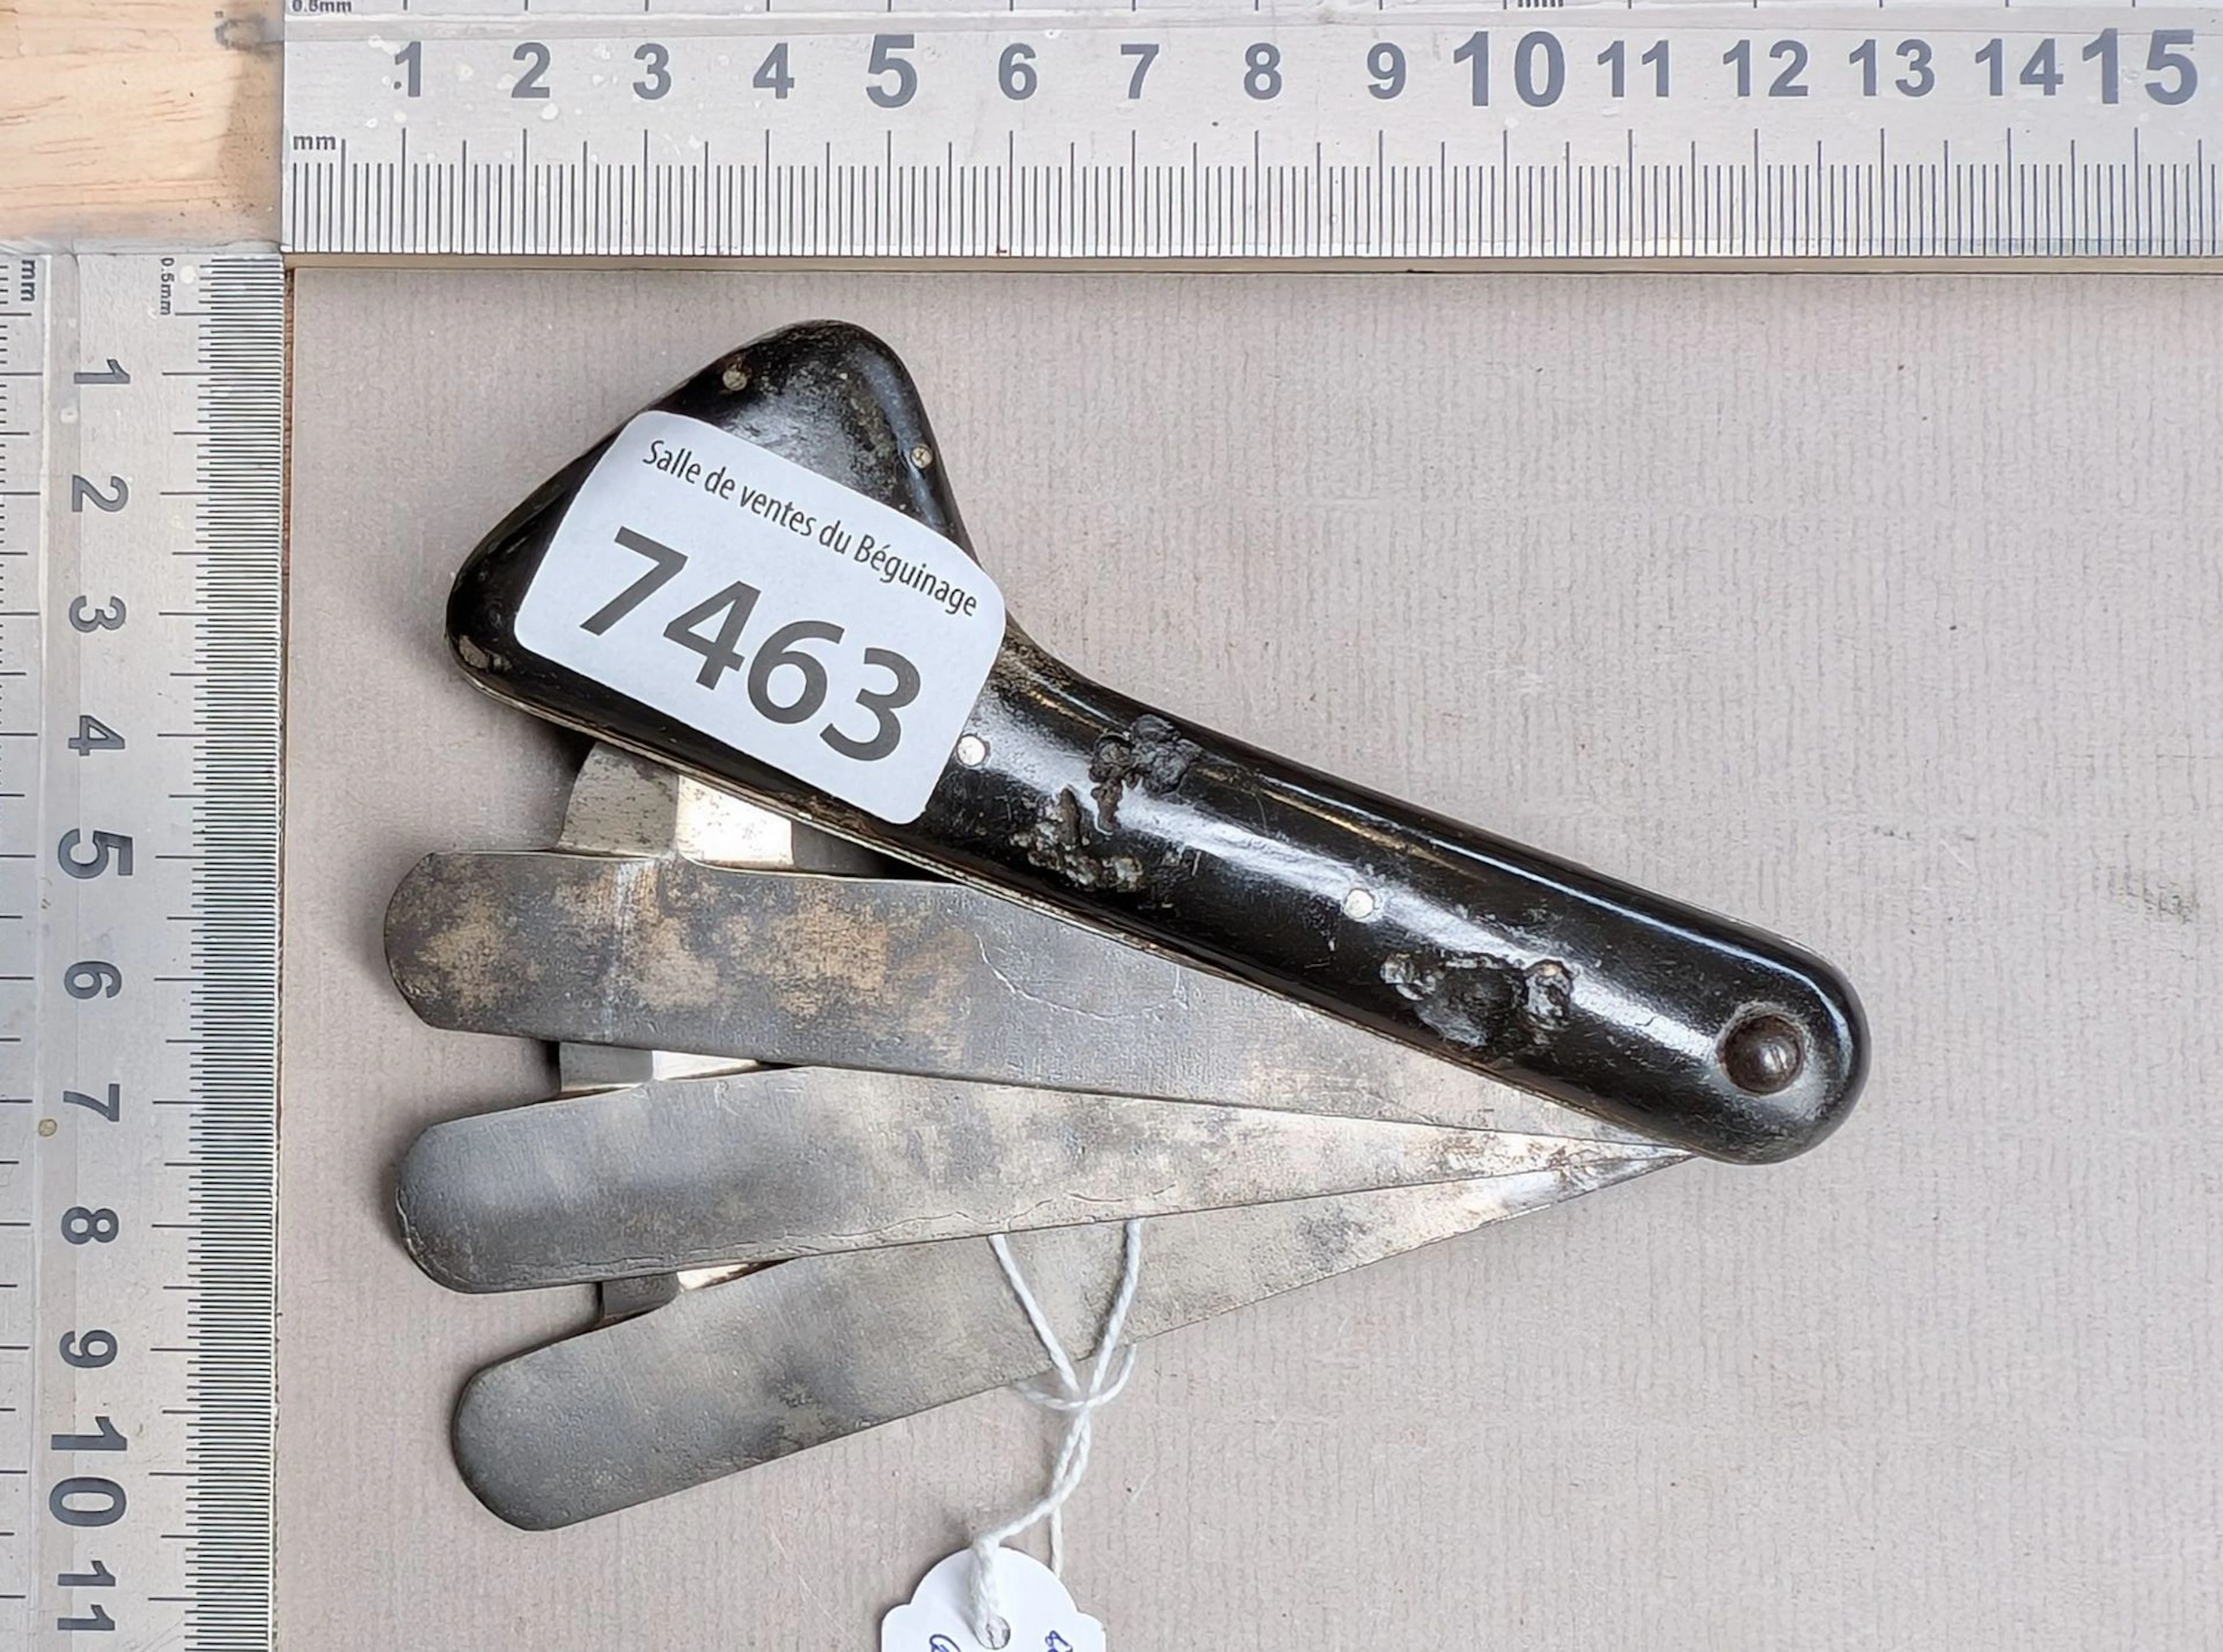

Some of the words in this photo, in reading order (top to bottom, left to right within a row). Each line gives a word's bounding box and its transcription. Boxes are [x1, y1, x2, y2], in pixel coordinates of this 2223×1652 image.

[394, 41, 421, 98] 1
[511, 42, 551, 98] 2
[632, 42, 672, 100] 3
[753, 42, 795, 100] 4
[865, 34, 918, 108] 5
[998, 42, 1037, 101] 6
[1120, 43, 1160, 100] 7
[1243, 42, 1282, 100] 8
[1367, 42, 1406, 100] 9
[1454, 31, 1565, 108] 10
[1597, 39, 1669, 98] 11
[1723, 39, 1809, 97] 12
[1849, 39, 1935, 97] 13
[1975, 38, 2064, 96] 14
[2082, 30, 2198, 105] 15
[293, 135, 336, 150] mm
[20, 259, 35, 302] mm
[160, 257, 175, 315] 0.5mm
[73, 358, 131, 385] 1
[71, 473, 129, 513] 2
[642, 439, 701, 484] Salle
[704, 466, 735, 500] de
[740, 486, 816, 537] ventes
[819, 520, 852, 555] du
[853, 534, 977, 617] Béguinage
[68, 595, 127, 633] 3
[579, 526, 922, 762] 7463
[68, 714, 126, 757] 4
[57, 828, 133, 880] 5
[63, 960, 122, 1000] 6
[63, 1083, 120, 1122] 7
[60, 1206, 119, 1245] 8
[59, 1330, 118, 1369] 9
[49, 1415, 127, 1528] 10
[57, 1560, 116, 1631] 11
